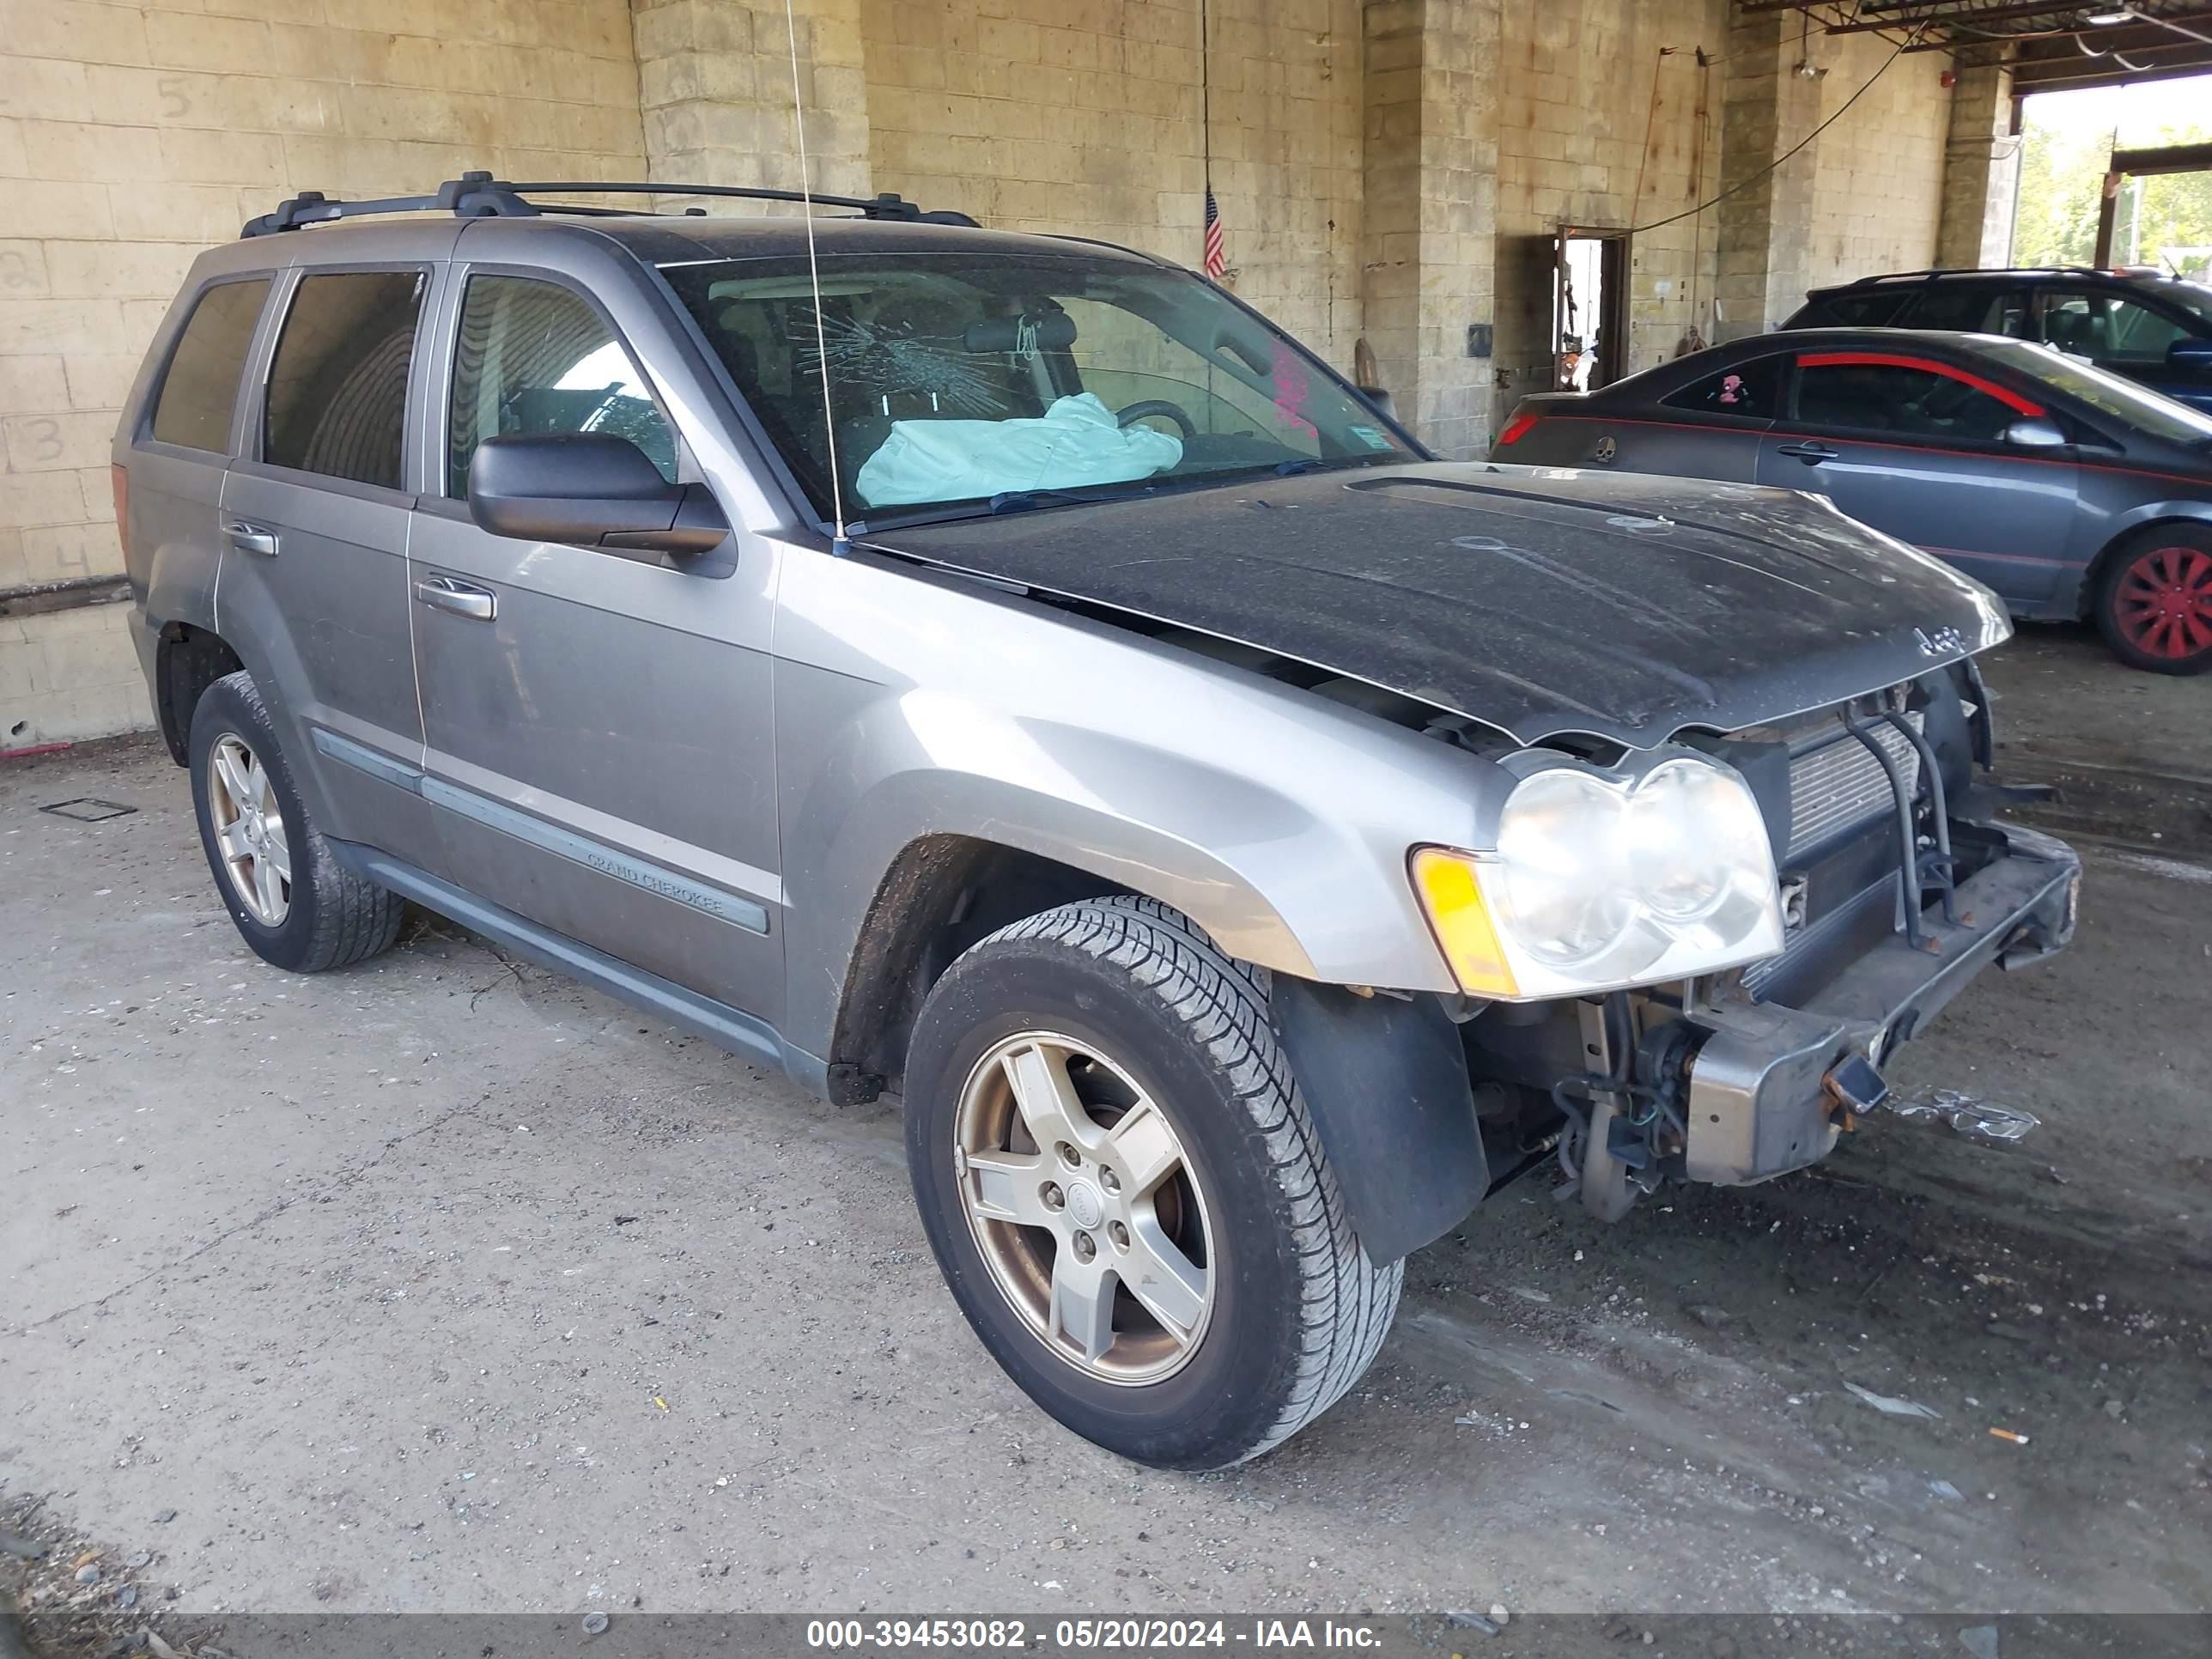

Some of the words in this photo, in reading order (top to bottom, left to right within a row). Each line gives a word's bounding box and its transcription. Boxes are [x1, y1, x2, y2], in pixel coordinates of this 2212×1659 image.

[156, 77, 191, 118] 5
[22, 417, 64, 462] 3
[56, 544, 92, 575] 4
[1912, 625, 1966, 657] Jeep
[587, 852, 639, 882] GRAND
[642, 872, 724, 915] CHEROKEE
